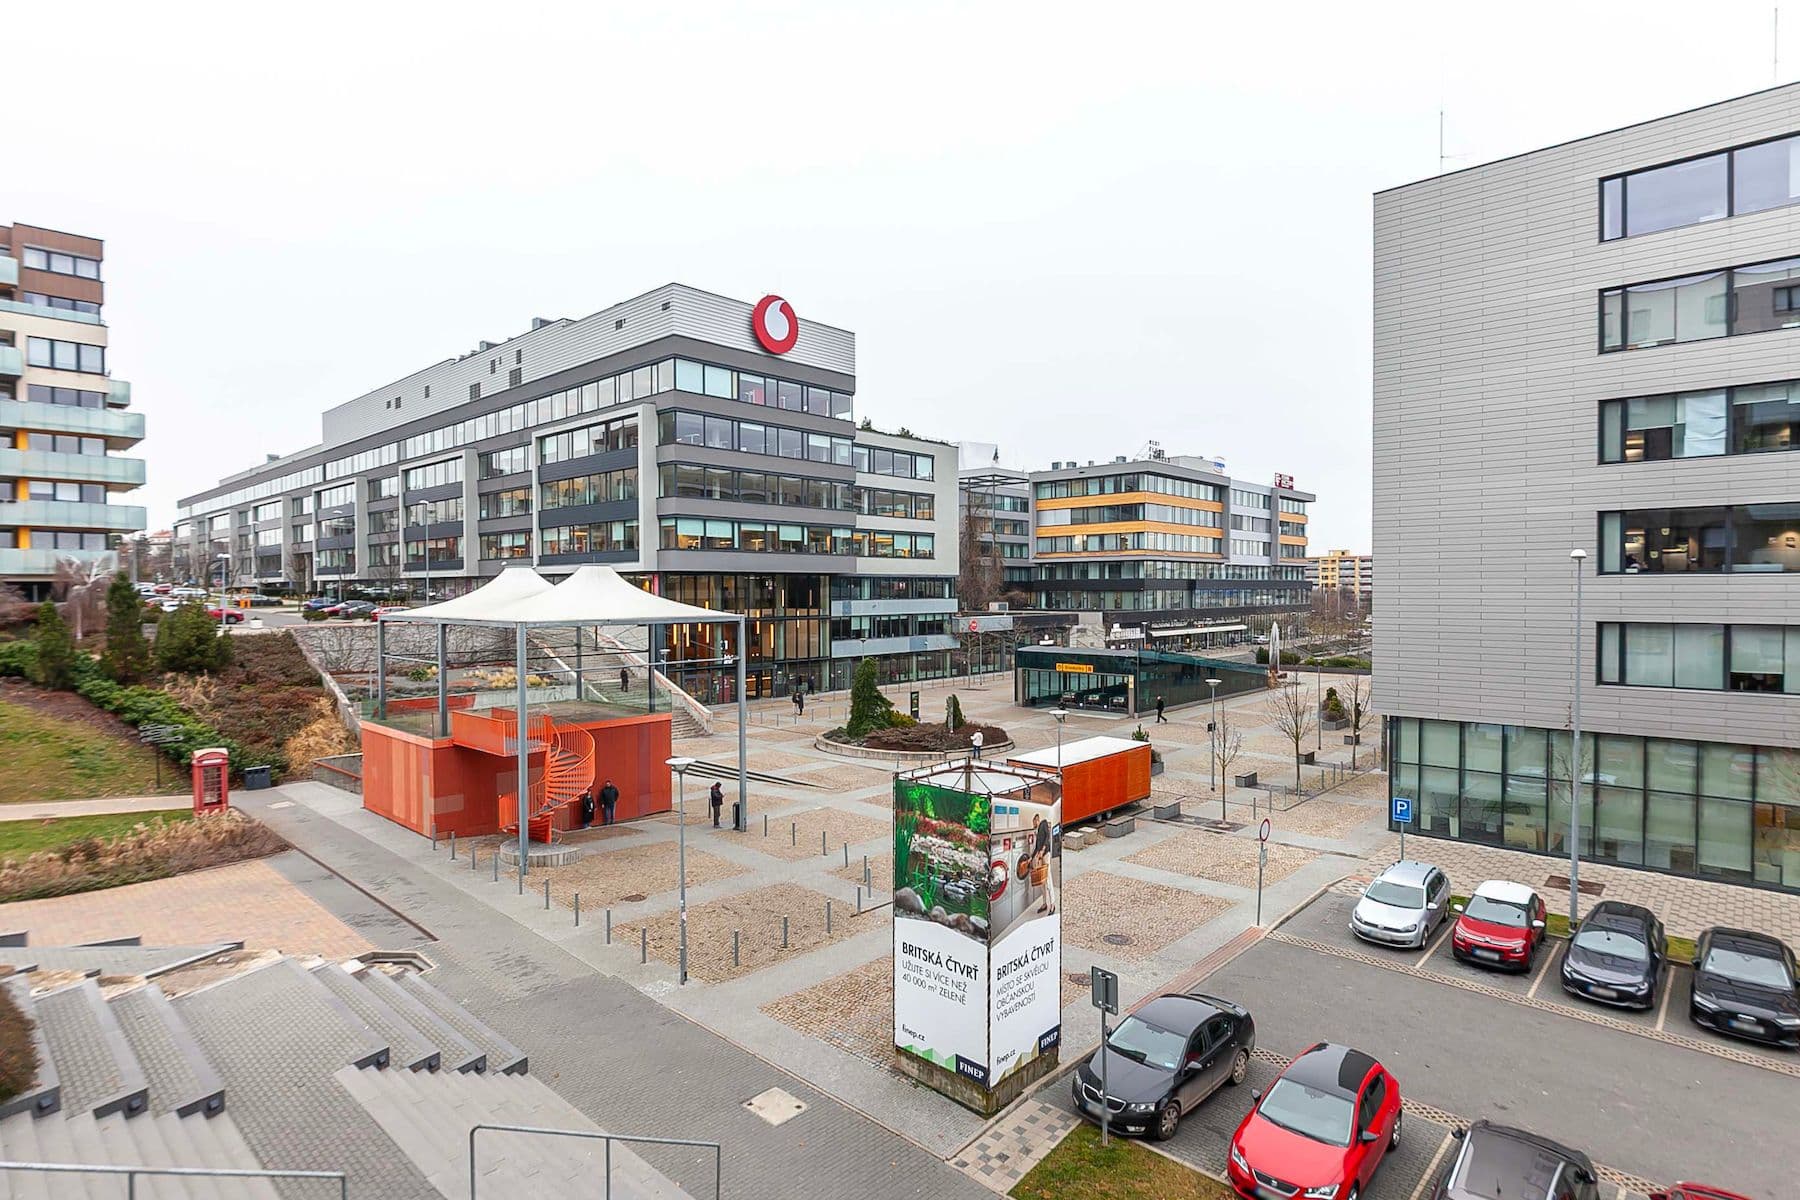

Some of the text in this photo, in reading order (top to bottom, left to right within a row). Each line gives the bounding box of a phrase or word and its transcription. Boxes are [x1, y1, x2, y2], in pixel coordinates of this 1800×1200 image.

[1397, 801, 1407, 814] P
[902, 941, 979, 981] BRITSKÁ ČTVRŤ
[996, 937, 1055, 981] BRITSKÁ ČTVRŤ
[902, 973, 911, 983] 40
[912, 976, 926, 989] 000
[925, 969, 931, 979] SI
[933, 971, 949, 986] VÍCE
[951, 979, 967, 993] NEŽ
[996, 961, 1049, 997] MÍSTO SE SKVĚLOU
[996, 981, 1034, 1010] OBČANSKOU
[996, 990, 1035, 1022] VYBAVENOSTÍ
[902, 1023, 926, 1042] finep.cz
[1040, 1031, 1058, 1049] FINEP
[959, 1061, 985, 1079] FINEP
